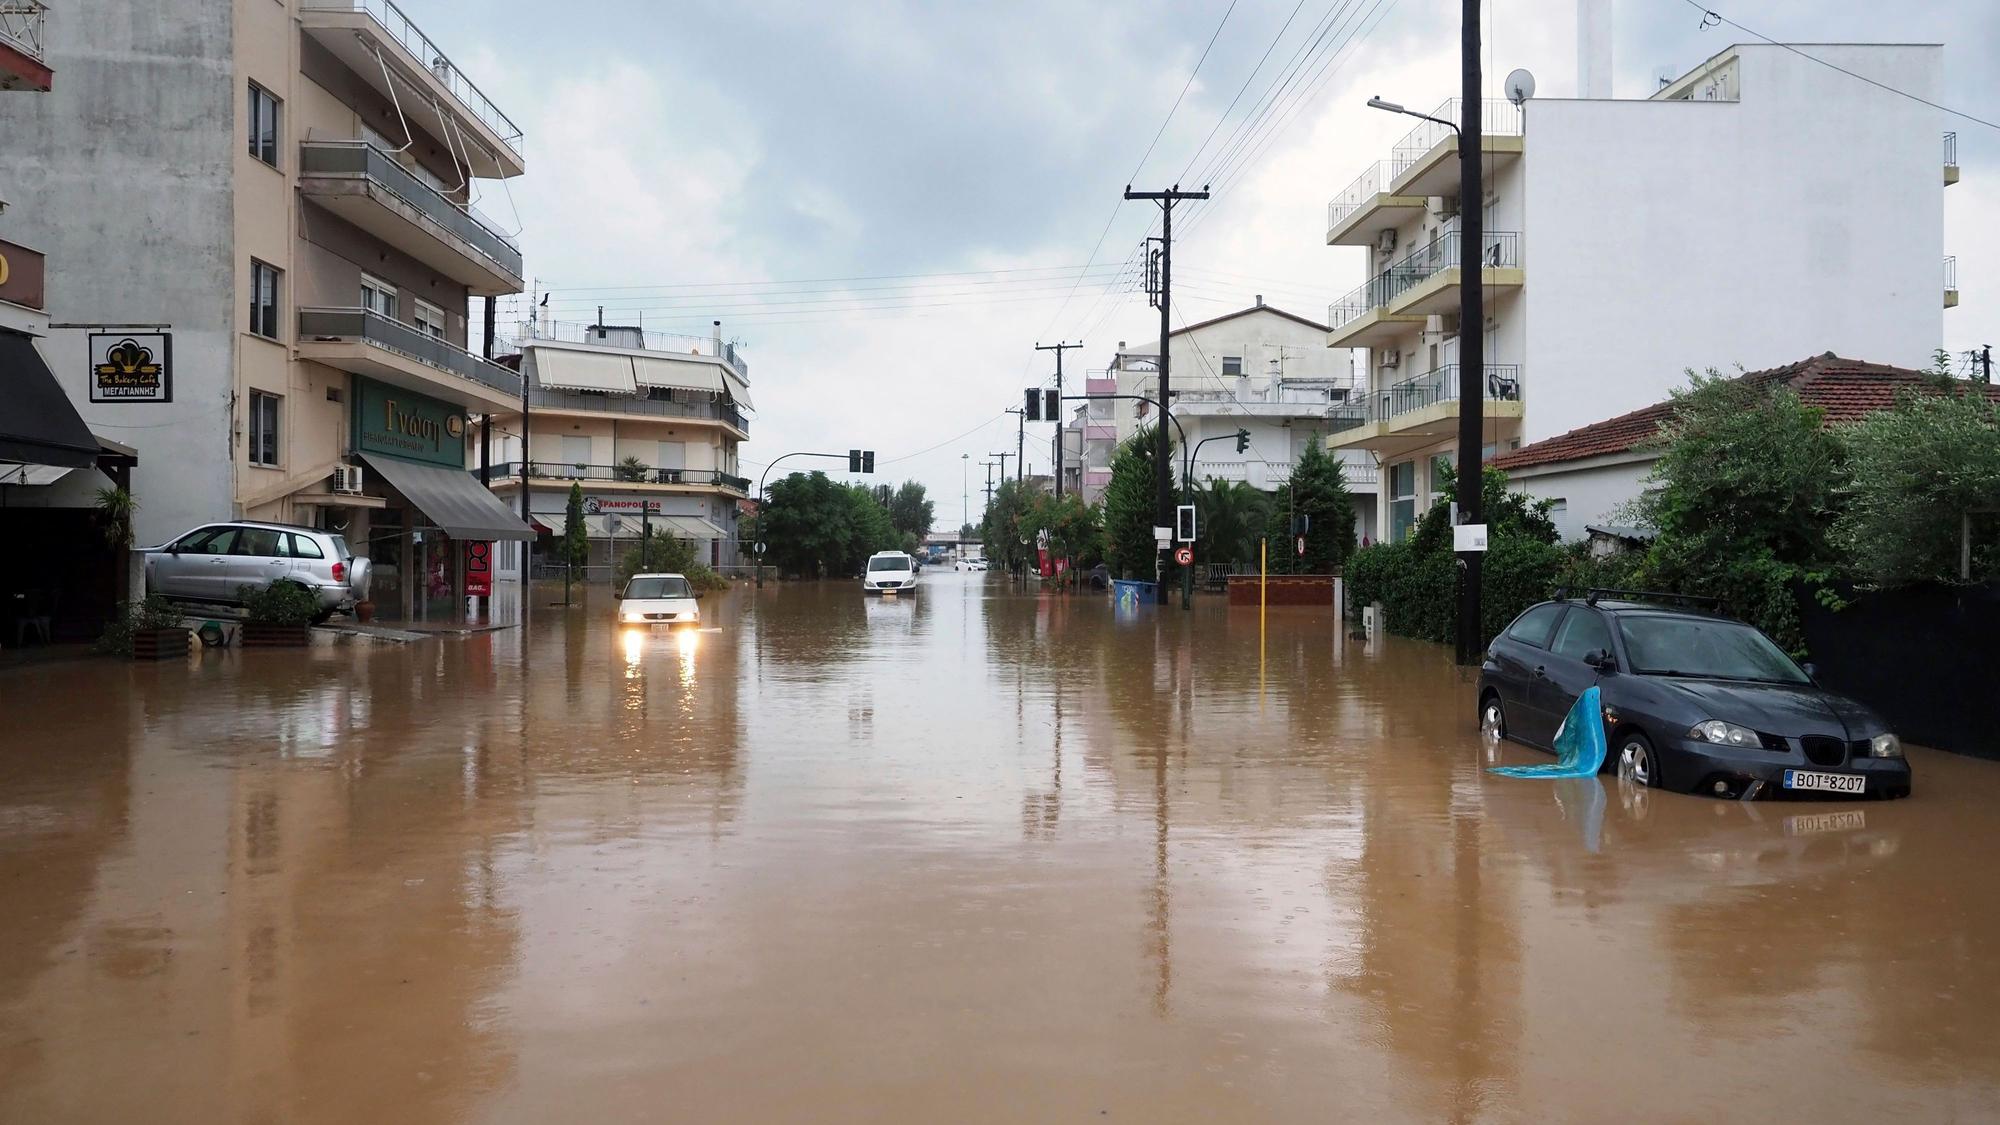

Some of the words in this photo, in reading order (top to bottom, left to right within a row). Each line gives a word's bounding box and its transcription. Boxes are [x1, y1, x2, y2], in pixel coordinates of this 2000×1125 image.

[100, 375, 112, 384] The
[114, 375, 138, 385] Bakery
[104, 387, 155, 396] ΜΕΓΑΓΙΑΝΝΗΣ
[386, 400, 440, 452] Γνώση
[598, 499, 661, 509] SPANOPOUOS
